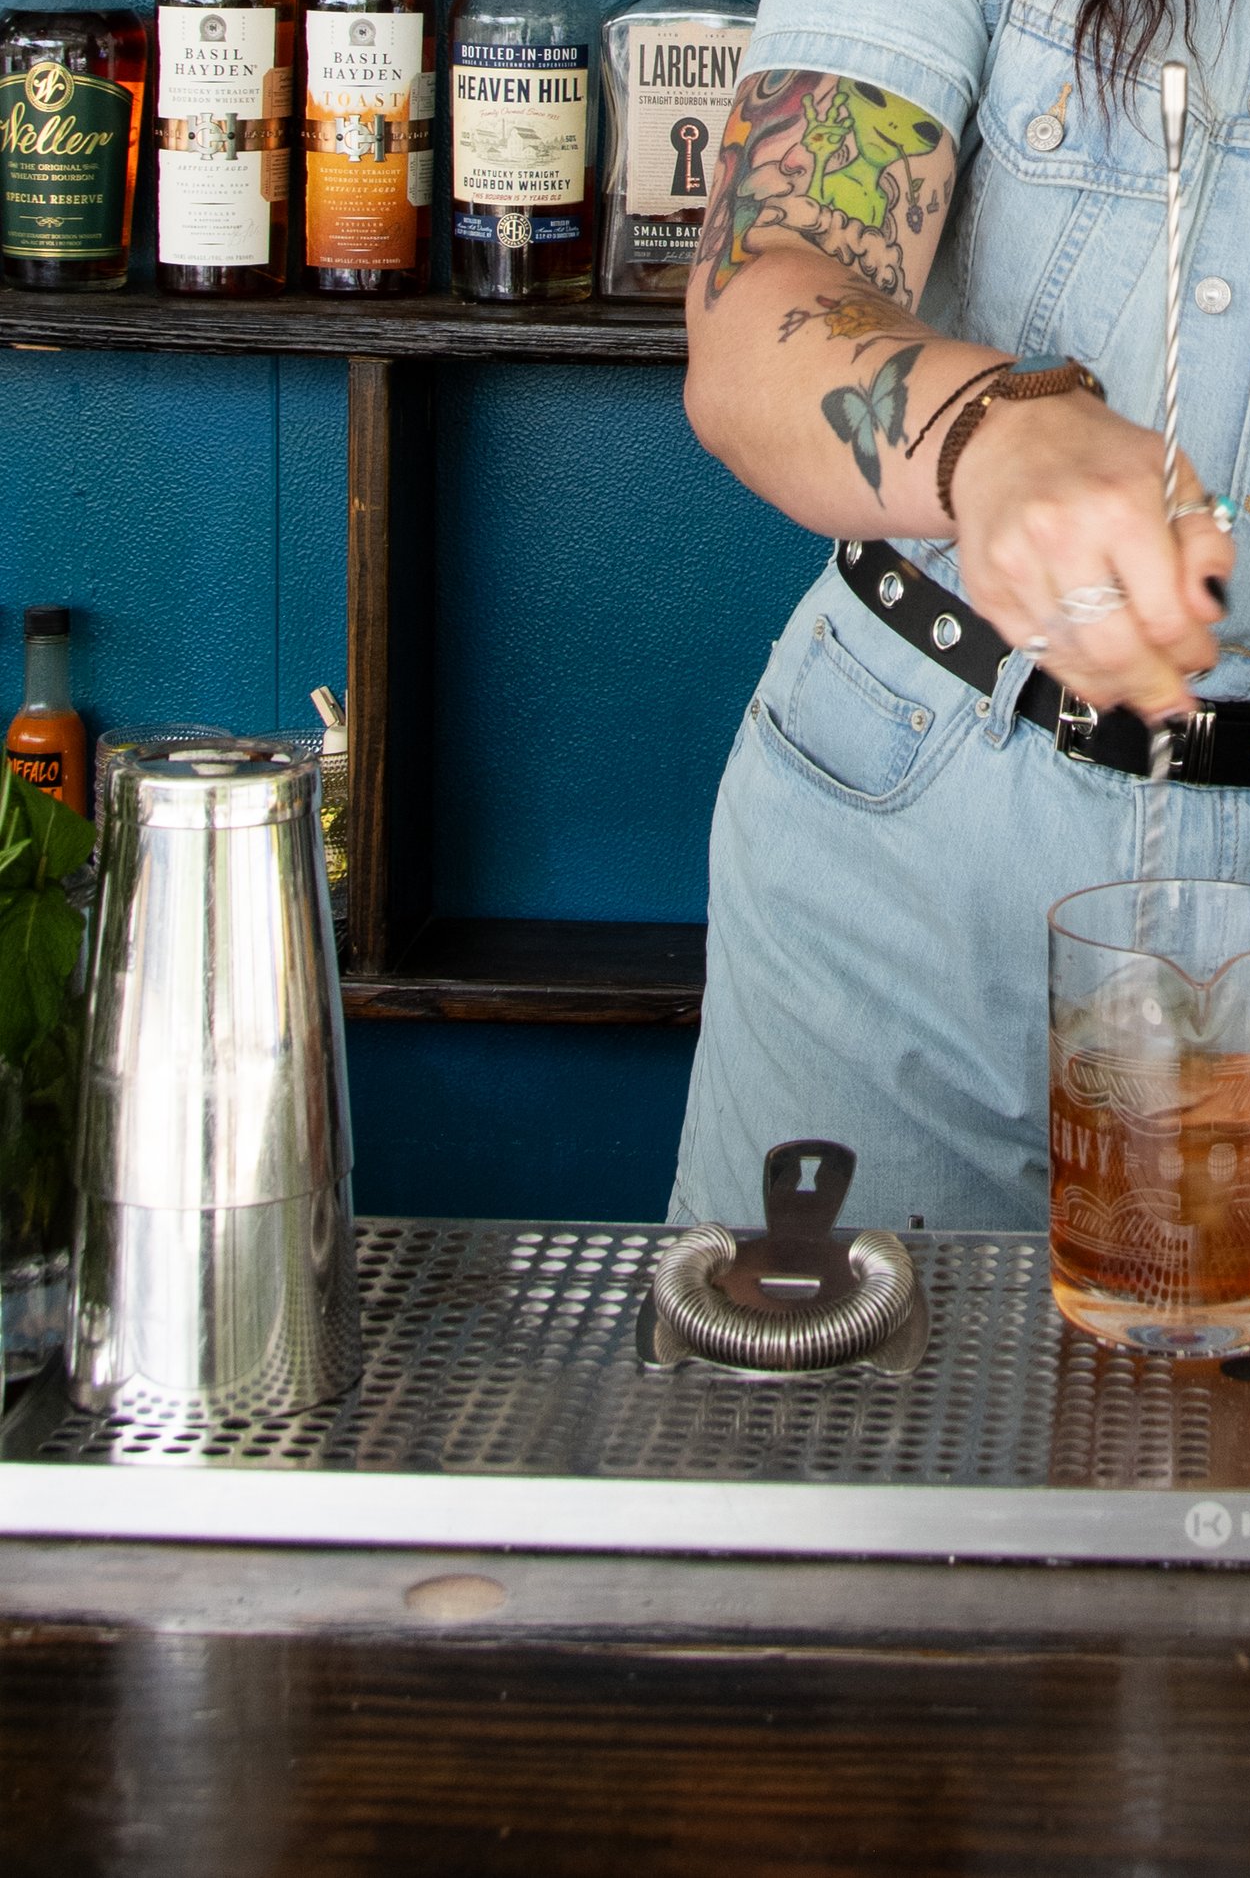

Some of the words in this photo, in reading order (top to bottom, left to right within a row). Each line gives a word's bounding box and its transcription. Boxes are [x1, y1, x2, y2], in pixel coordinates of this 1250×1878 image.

[185, 47, 243, 61] BASIL
[334, 51, 392, 65] BASIL
[461, 44, 578, 61] BOTTLED-IN-BOND
[175, 63, 254, 76] HAYDEN
[639, 44, 742, 89] LARCENY
[323, 67, 402, 80] HAYDEN
[34, 67, 65, 103] W
[168, 87, 210, 95] KENTUCKY
[458, 74, 530, 103] HEAVEN
[539, 77, 582, 103] HILL
[323, 90, 401, 107] TOAST
[639, 95, 672, 105] STRAIGHT
[674, 96, 708, 106] BOURBON
[710, 97, 735, 107] WHISK
[480, 109, 499, 118] Family
[526, 108, 546, 117] Since
[0, 101, 114, 155] Weller
[20, 163, 36, 171] THE
[38, 163, 82, 171] ORIGINAL
[10, 172, 49, 181] WHEATED
[51, 173, 95, 182] BOURBON
[472, 169, 514, 179] KENTUCKY
[518, 170, 560, 179] STRAIGHT
[463, 177, 513, 190] BOURBON
[519, 179, 571, 191] WHISKEY
[6, 191, 46, 204] SPECIAL
[49, 194, 103, 204] RESERVE
[472, 192, 484, 200] THIS
[484, 193, 512, 201] BOURBON
[633, 225, 671, 237] SMALL
[676, 227, 702, 237] BATC
[634, 240, 667, 248] WHEATED
